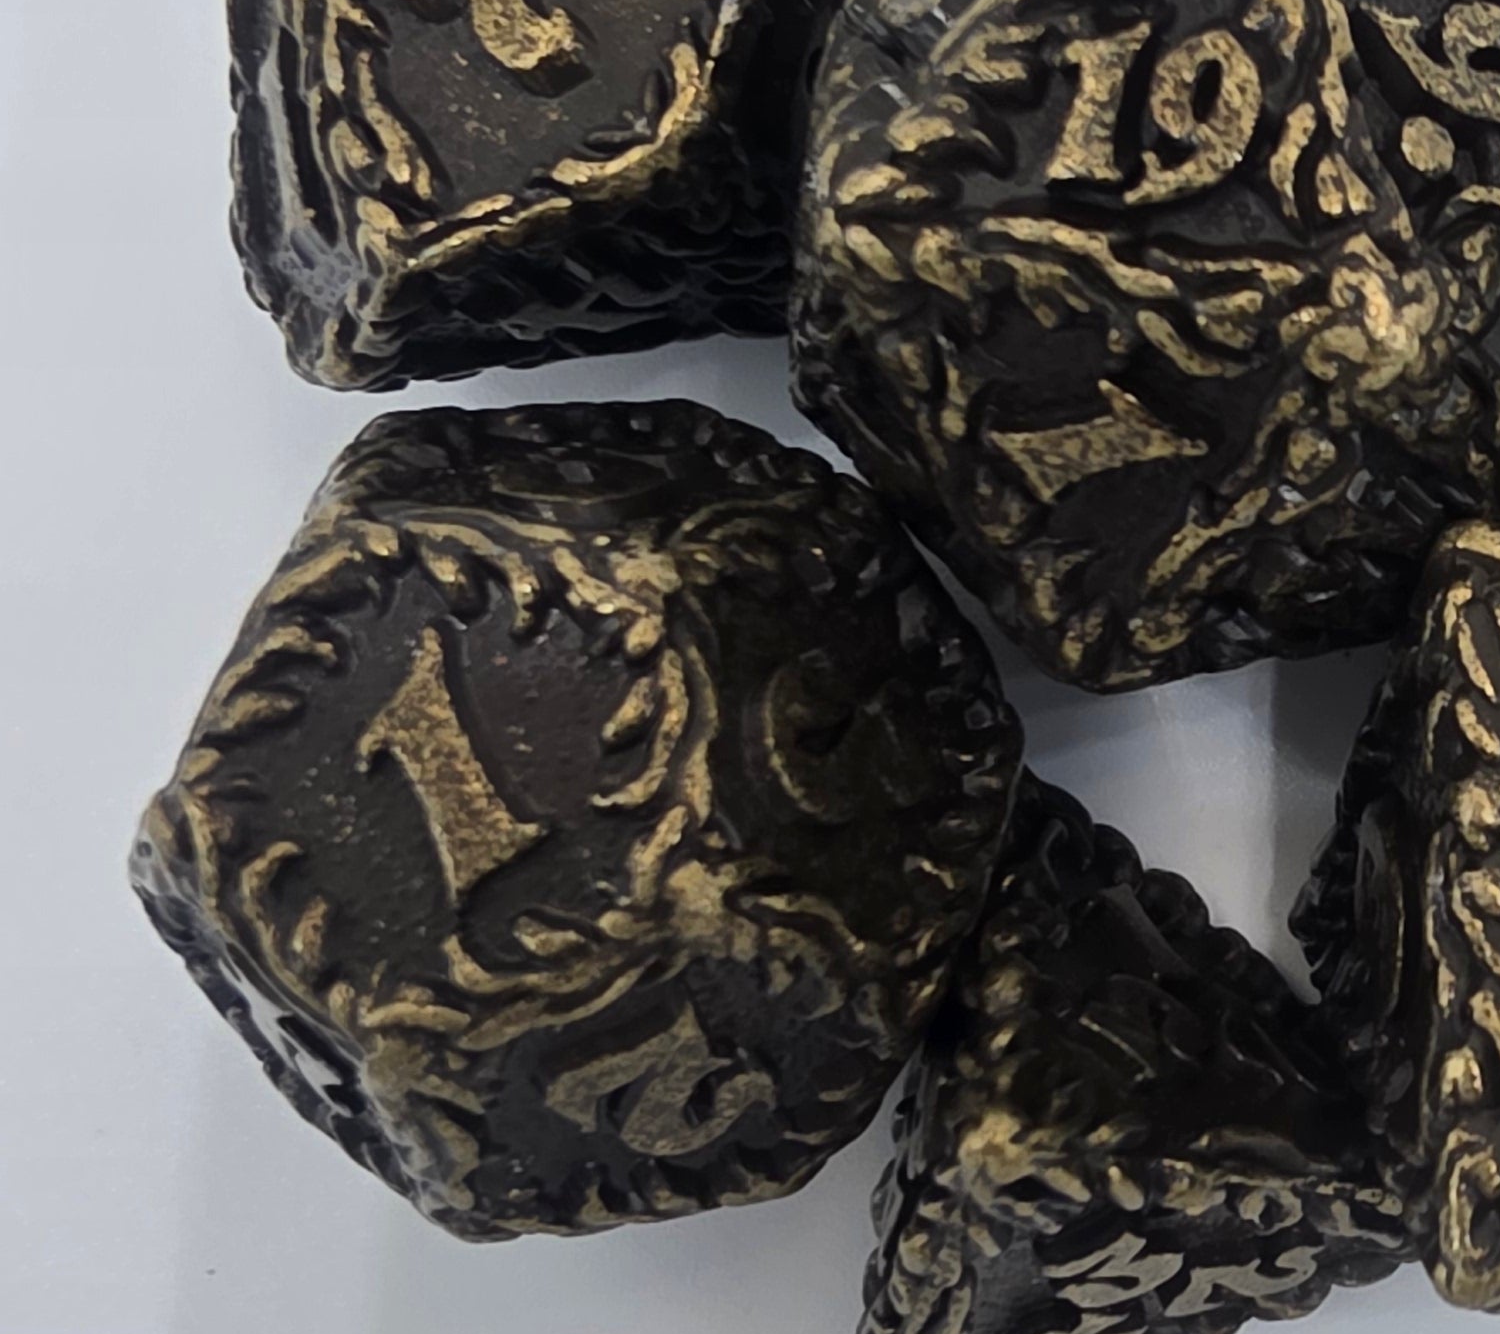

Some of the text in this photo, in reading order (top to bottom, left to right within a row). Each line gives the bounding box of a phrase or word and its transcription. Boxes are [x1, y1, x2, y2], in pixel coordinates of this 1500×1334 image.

[1046, 19, 1263, 205] 19
[992, 379, 1208, 505] 1
[355, 625, 552, 905] 1
